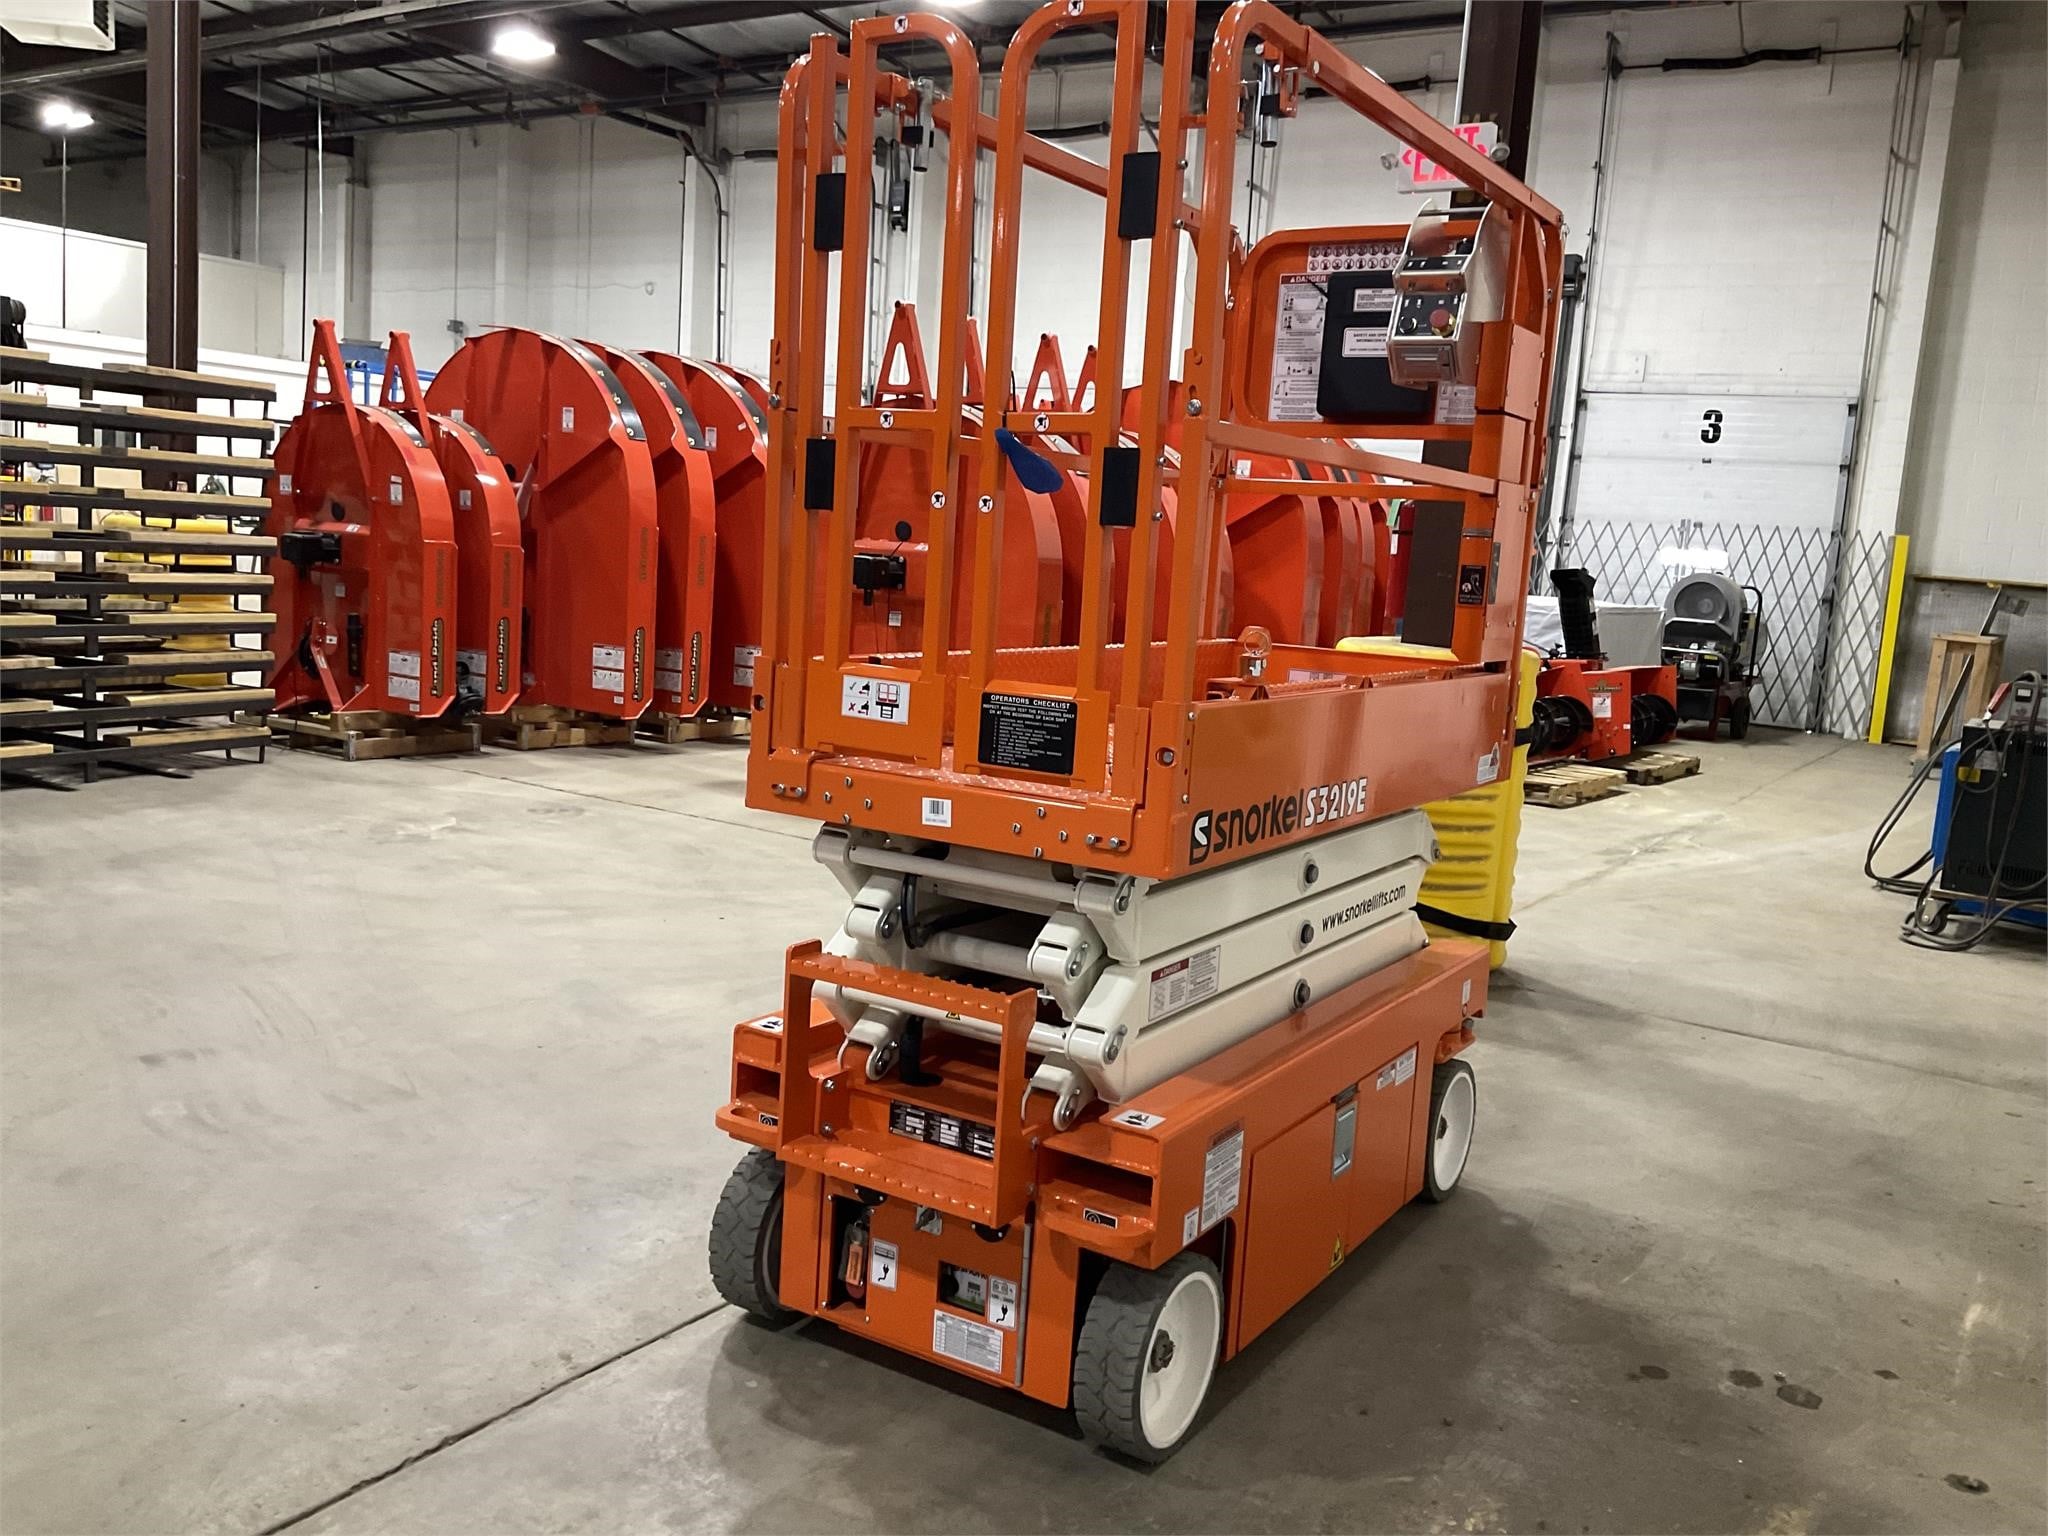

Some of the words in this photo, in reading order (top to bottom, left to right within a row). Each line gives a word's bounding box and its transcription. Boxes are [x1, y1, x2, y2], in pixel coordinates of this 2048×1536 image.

[1701, 410, 1723, 443] 3
[990, 694, 1029, 704] OPERATORS
[1033, 700, 1070, 709] CHECKLIST
[1213, 789, 1304, 853] snorkel
[1304, 777, 1368, 827] S3219E
[1321, 885, 1406, 933] www.snorkellifts.com
